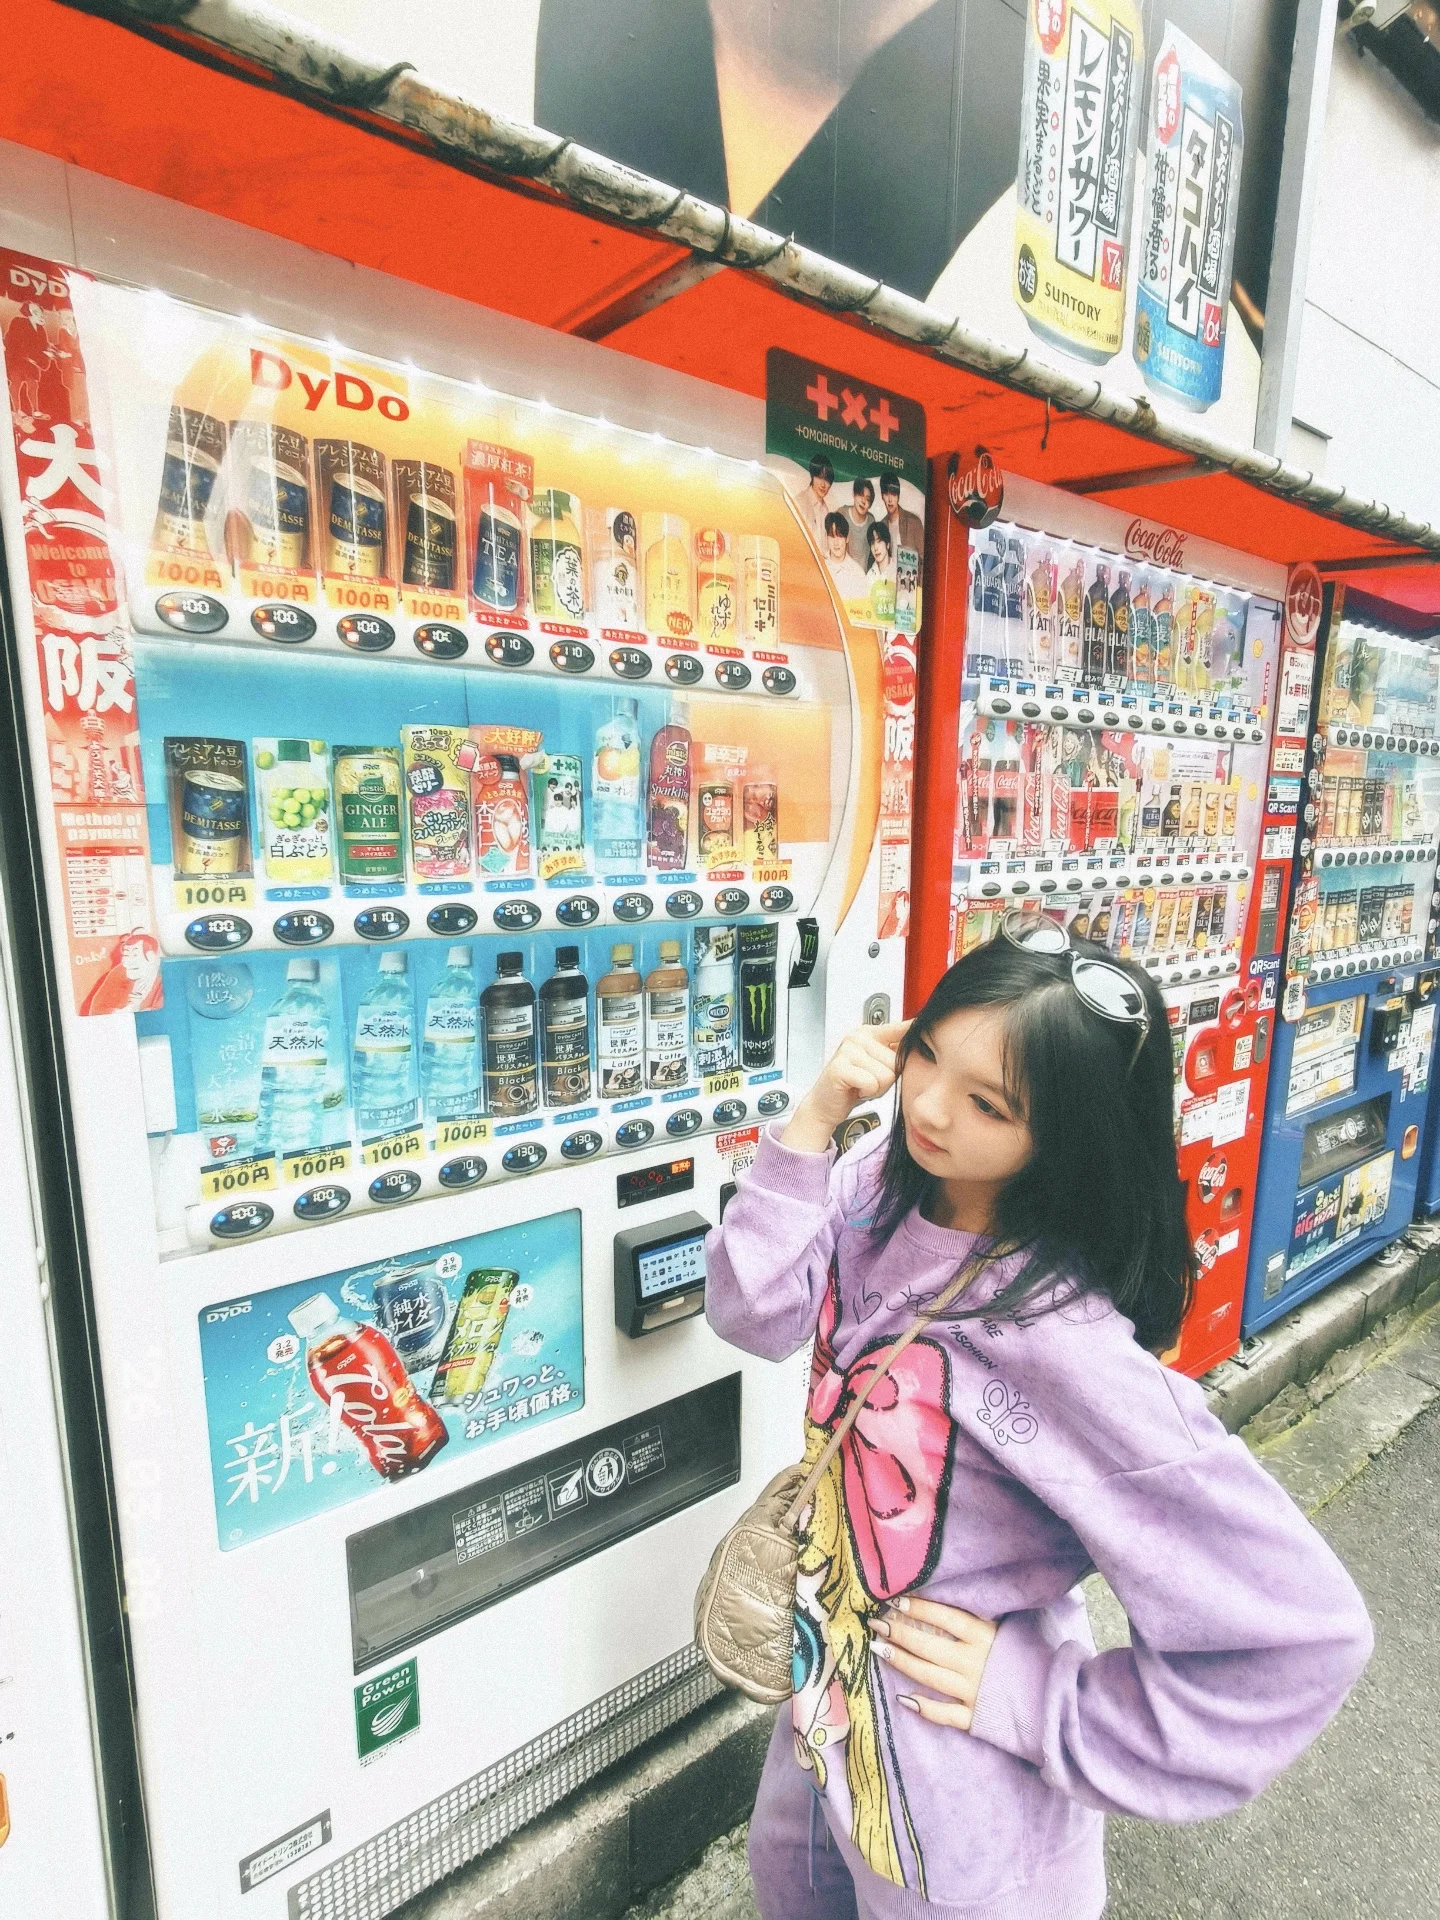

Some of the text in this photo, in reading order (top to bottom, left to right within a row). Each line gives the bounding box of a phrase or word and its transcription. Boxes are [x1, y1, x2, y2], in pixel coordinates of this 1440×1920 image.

[1099, 40, 1132, 224] こだわり酒場
[1069, 27, 1105, 262] レモンサワー
[1175, 128, 1208, 321] タコハイ
[1044, 282, 1101, 322] SUNTORY
[249, 347, 410, 422] DyDo
[317, 444, 379, 468] プレミアム豆
[1124, 518, 1189, 569] Coca-Cola
[481, 539, 519, 568] TEA
[68, 561, 88, 578] to
[157, 561, 223, 588] 100円
[252, 579, 310, 602] 100円
[336, 588, 390, 610] 100円
[411, 599, 460, 619] 100円
[718, 594, 732, 630] ゆず
[668, 616, 692, 632] NEW
[885, 683, 915, 699] OSAKA
[168, 743, 237, 758] プレミアム豆
[411, 735, 452, 752] ふって!
[181, 754, 244, 769] ブレンドのコク
[408, 767, 437, 782] 炭酸
[411, 780, 440, 794] ゼリー
[344, 803, 398, 818] GINGER
[1268, 803, 1279, 814] QR
[61, 811, 142, 828] Method of
[184, 812, 242, 831] DEMITASSE
[360, 817, 388, 829] ALE
[413, 816, 469, 841] スパークリング
[475, 800, 494, 849] 杏仁
[270, 843, 328, 858] 白ぶどう
[544, 857, 578, 874] おすすめ
[757, 869, 789, 882] 100円
[185, 886, 247, 905] 100円
[1249, 959, 1263, 974] QR
[360, 1024, 410, 1038] 天然水
[429, 1015, 475, 1030] 天然水
[268, 1035, 325, 1050] 天然水
[557, 1065, 583, 1077] Black
[498, 1075, 526, 1087] Black
[708, 1077, 740, 1094] 100円
[443, 1125, 488, 1143] 100円
[574, 1133, 592, 1145] 130
[371, 1138, 420, 1164] 100円
[517, 1145, 535, 1158] 130
[293, 1155, 346, 1179] 100円
[212, 1166, 270, 1193] 100円
[442, 1265, 458, 1275] 発売
[443, 1257, 456, 1267] 3.9
[515, 1294, 530, 1304] 発売
[516, 1287, 528, 1297] 3.9
[206, 1302, 253, 1325] DyDo
[393, 1291, 430, 1319] 純水
[388, 1305, 441, 1335] サイダー
[980, 1319, 1004, 1339] ARE
[448, 1317, 507, 1345] メロン
[275, 1347, 296, 1359] 発売
[276, 1339, 292, 1352] 3.2
[463, 1366, 568, 1414] シュワっと、
[326, 1362, 410, 1473] Cola
[464, 1383, 581, 1442] お手頃価格。
[362, 1666, 411, 1697] Green
[361, 1675, 413, 1708] Power
